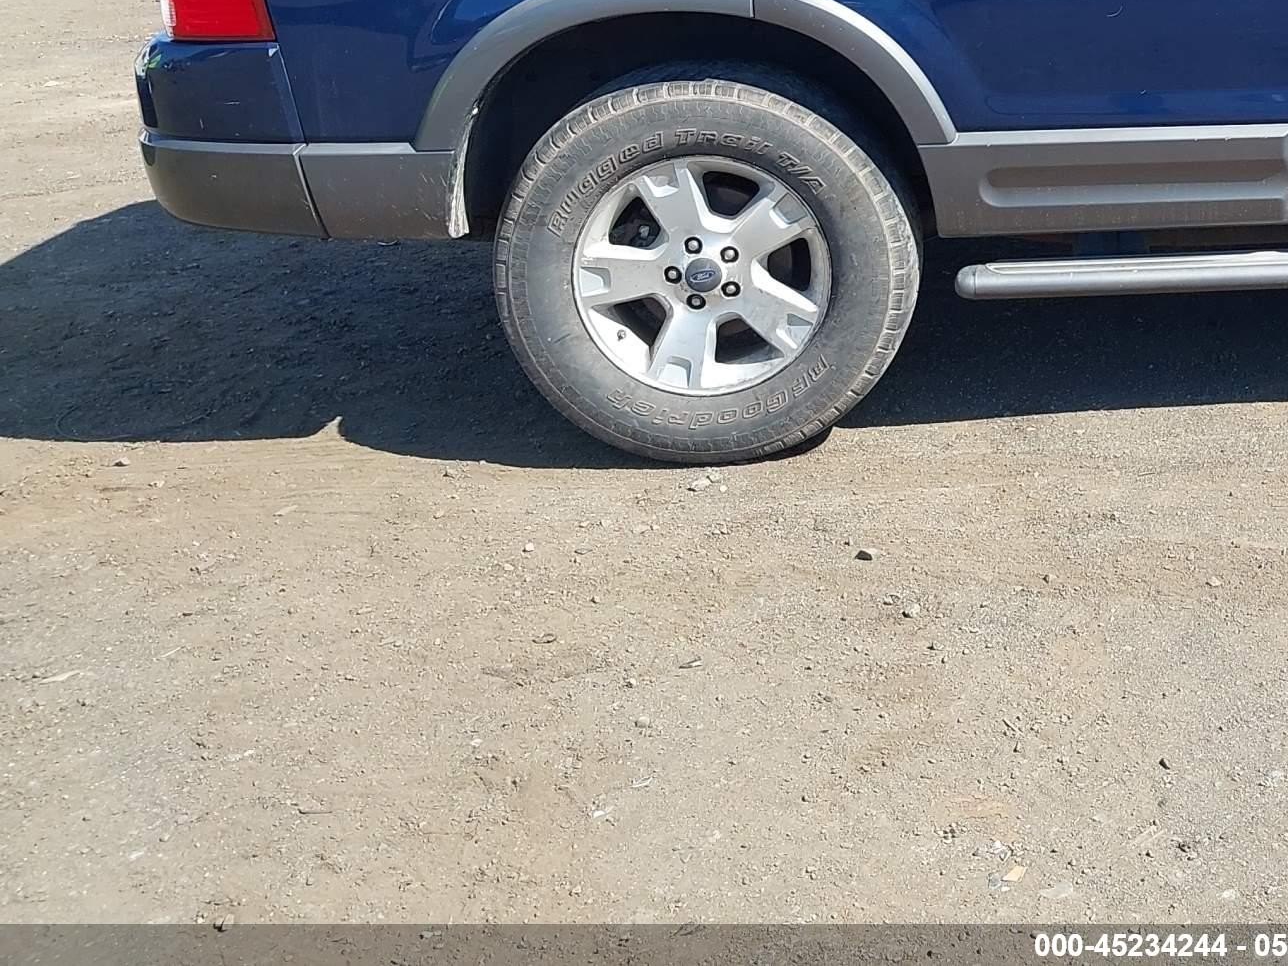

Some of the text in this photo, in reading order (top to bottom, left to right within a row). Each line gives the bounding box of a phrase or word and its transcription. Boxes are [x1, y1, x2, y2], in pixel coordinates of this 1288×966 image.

[547, 128, 827, 238] Rugged Trail T/A
